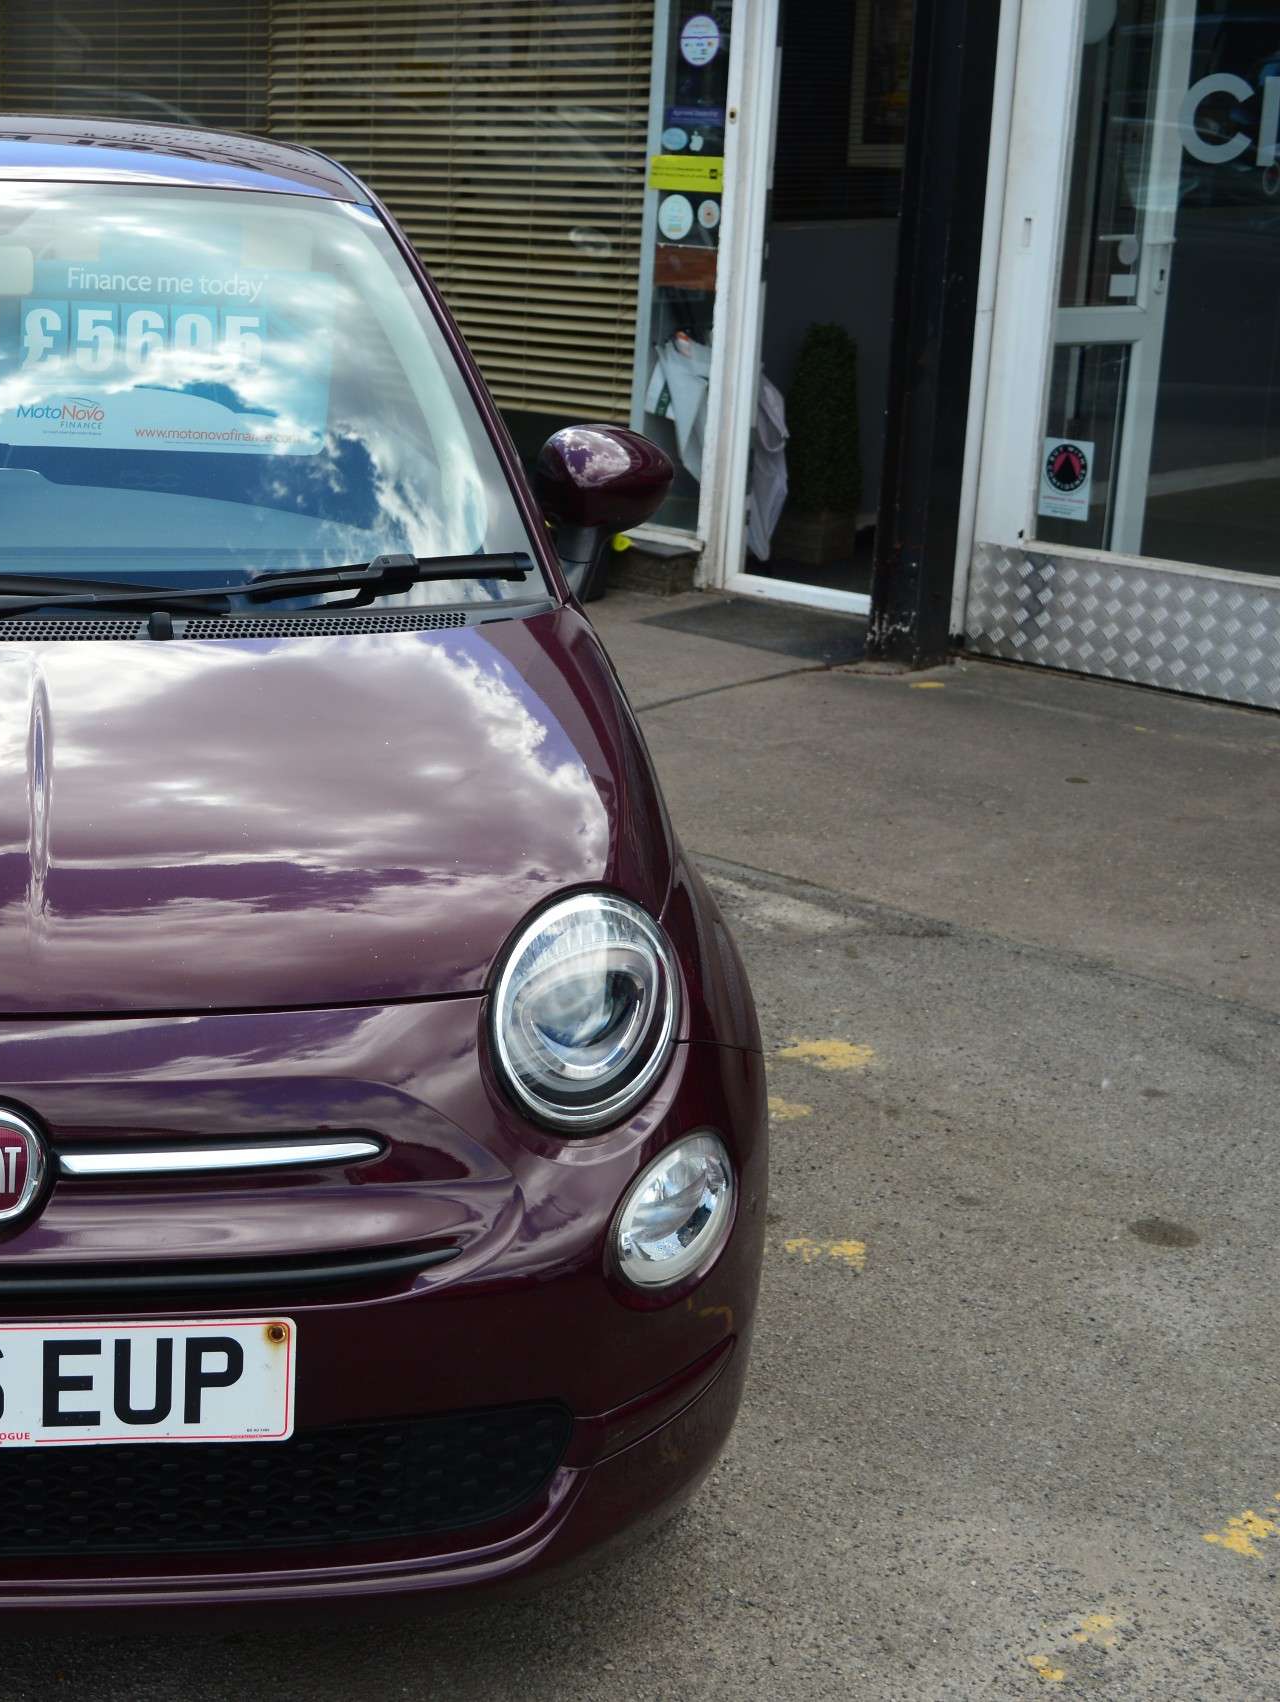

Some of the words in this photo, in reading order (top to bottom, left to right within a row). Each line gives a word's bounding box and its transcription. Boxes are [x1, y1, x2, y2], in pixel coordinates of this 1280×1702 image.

[68, 268, 152, 292] Finance
[158, 278, 194, 293] me
[199, 272, 264, 303] today
[16, 404, 105, 421] MotoNovo
[60, 420, 103, 430] FINANCE
[42, 1336, 244, 1427] EUP
